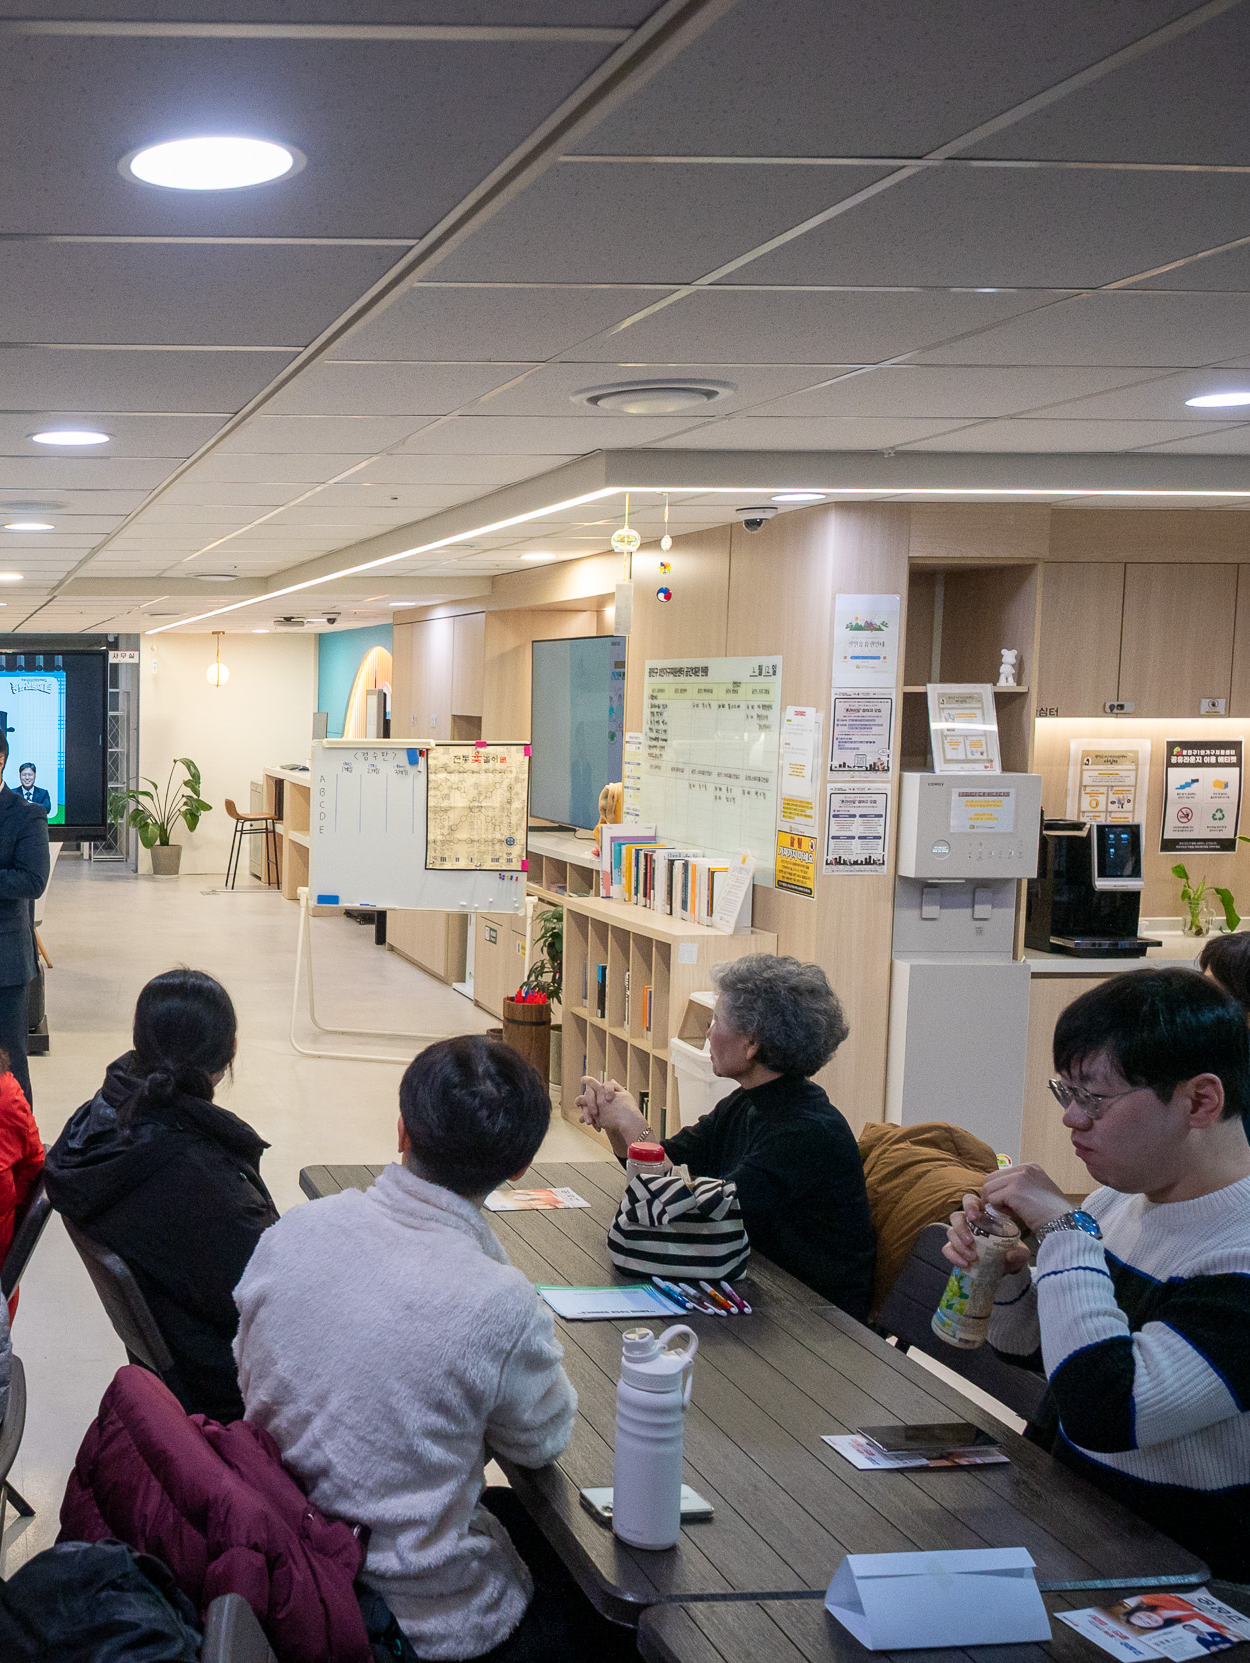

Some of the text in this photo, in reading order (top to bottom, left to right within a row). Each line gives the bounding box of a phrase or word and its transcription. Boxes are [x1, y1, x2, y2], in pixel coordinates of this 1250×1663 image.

[1036, 707, 1059, 717] 심터
[319, 775, 326, 783] A
[319, 787, 326, 797] B
[319, 800, 326, 809] C
[319, 811, 327, 821] D
[319, 825, 326, 835] E
[797, 850, 814, 864] 마세요
